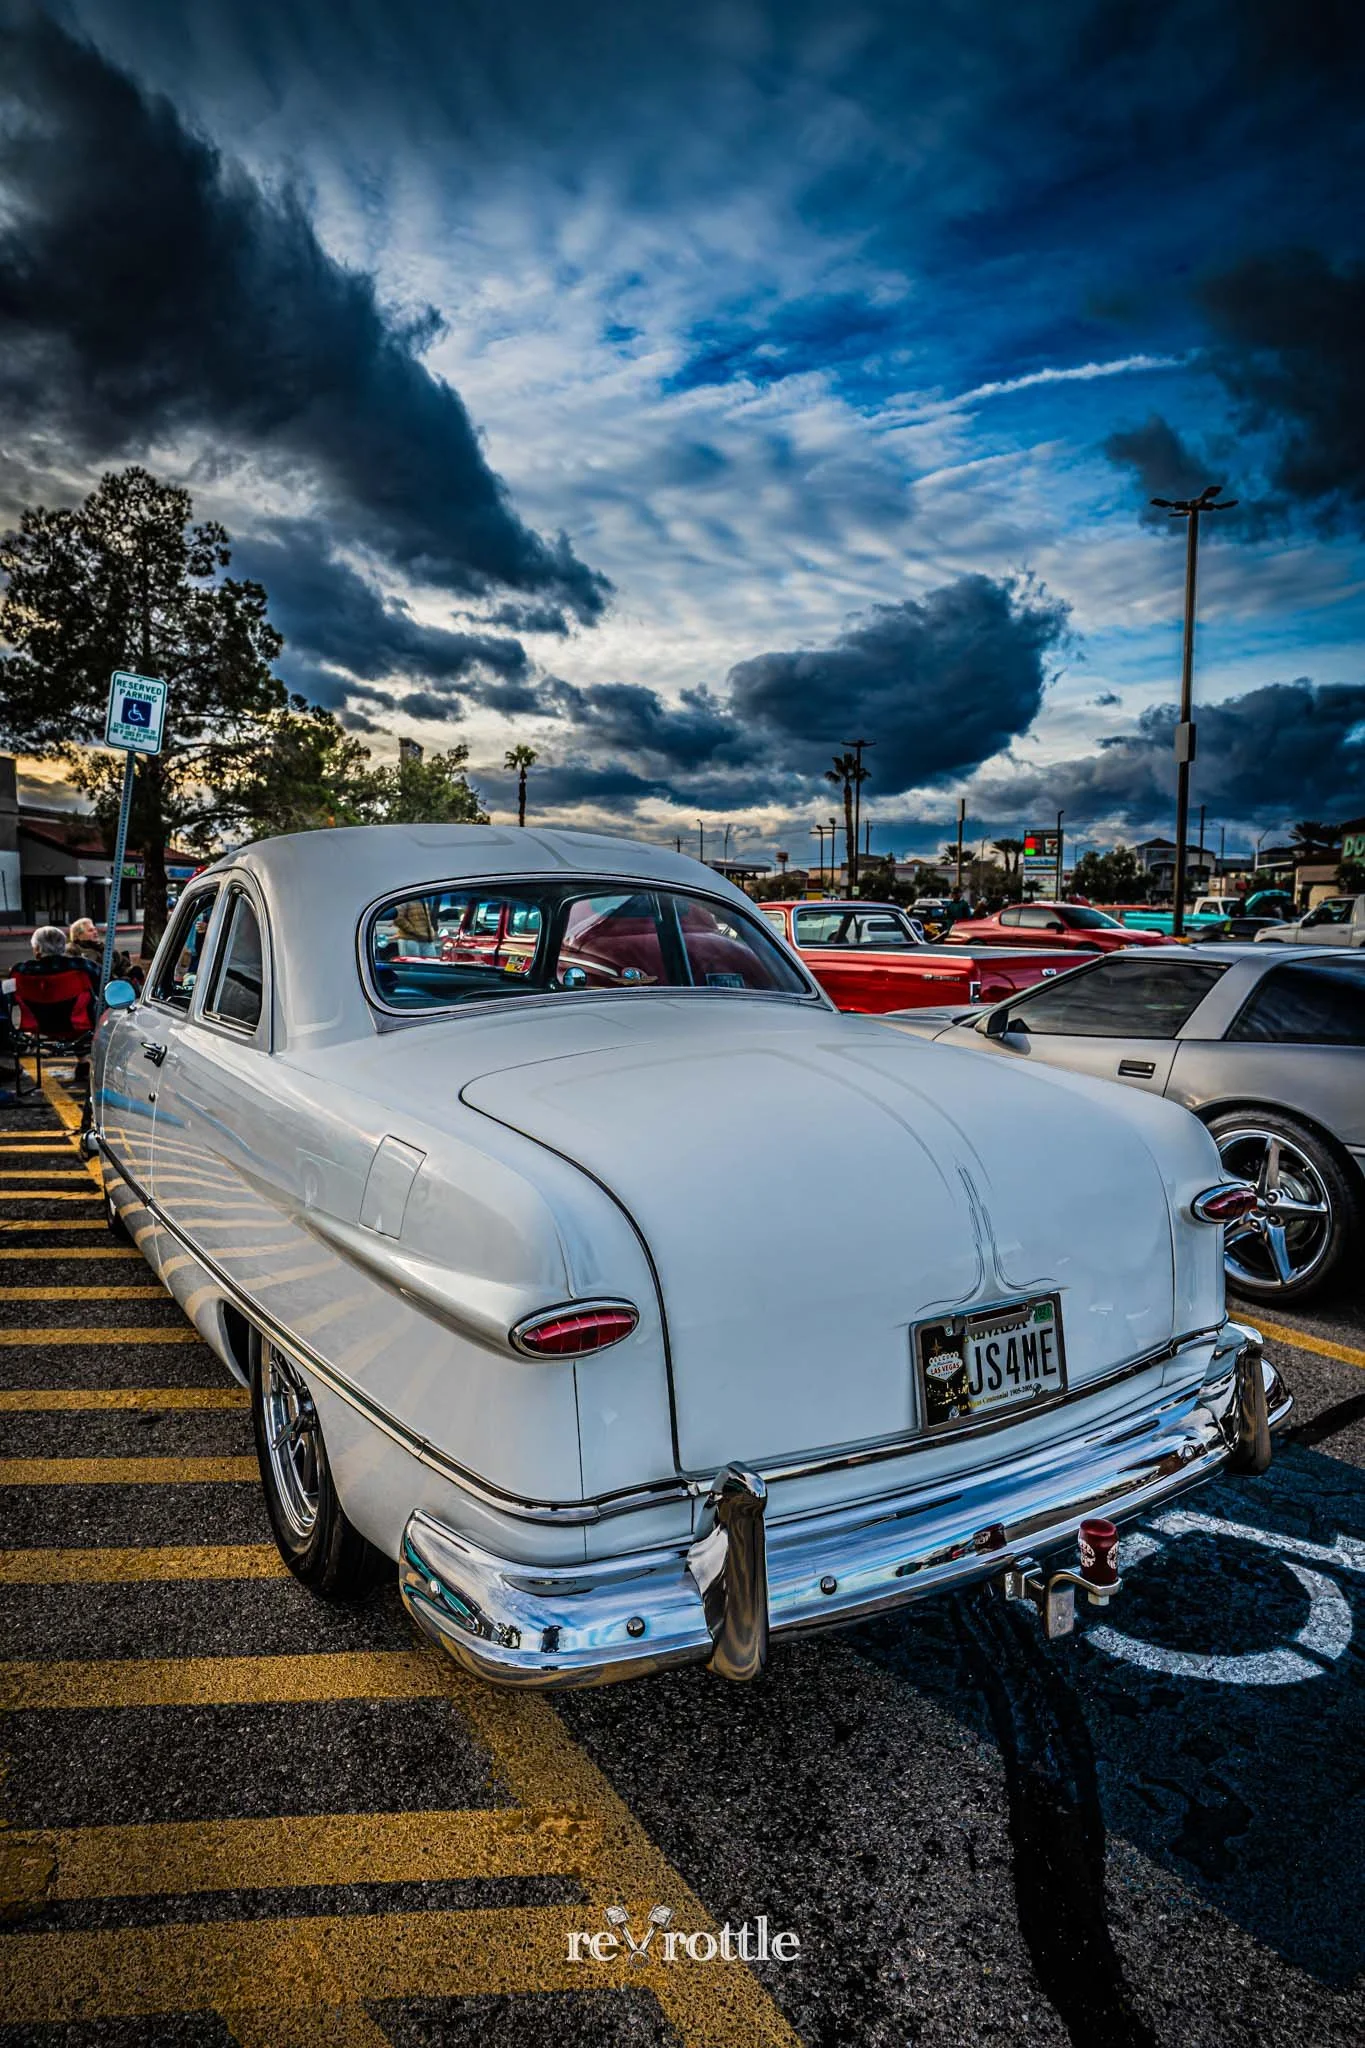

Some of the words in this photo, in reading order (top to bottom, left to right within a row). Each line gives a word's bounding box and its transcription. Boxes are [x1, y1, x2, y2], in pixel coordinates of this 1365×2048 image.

[117, 679, 161, 696] RESERVED
[119, 689, 157, 703] PARKING
[930, 1367, 941, 1375] LAS
[942, 1362, 960, 1371] VEGAS
[969, 1328, 1057, 1396] JS4ME
